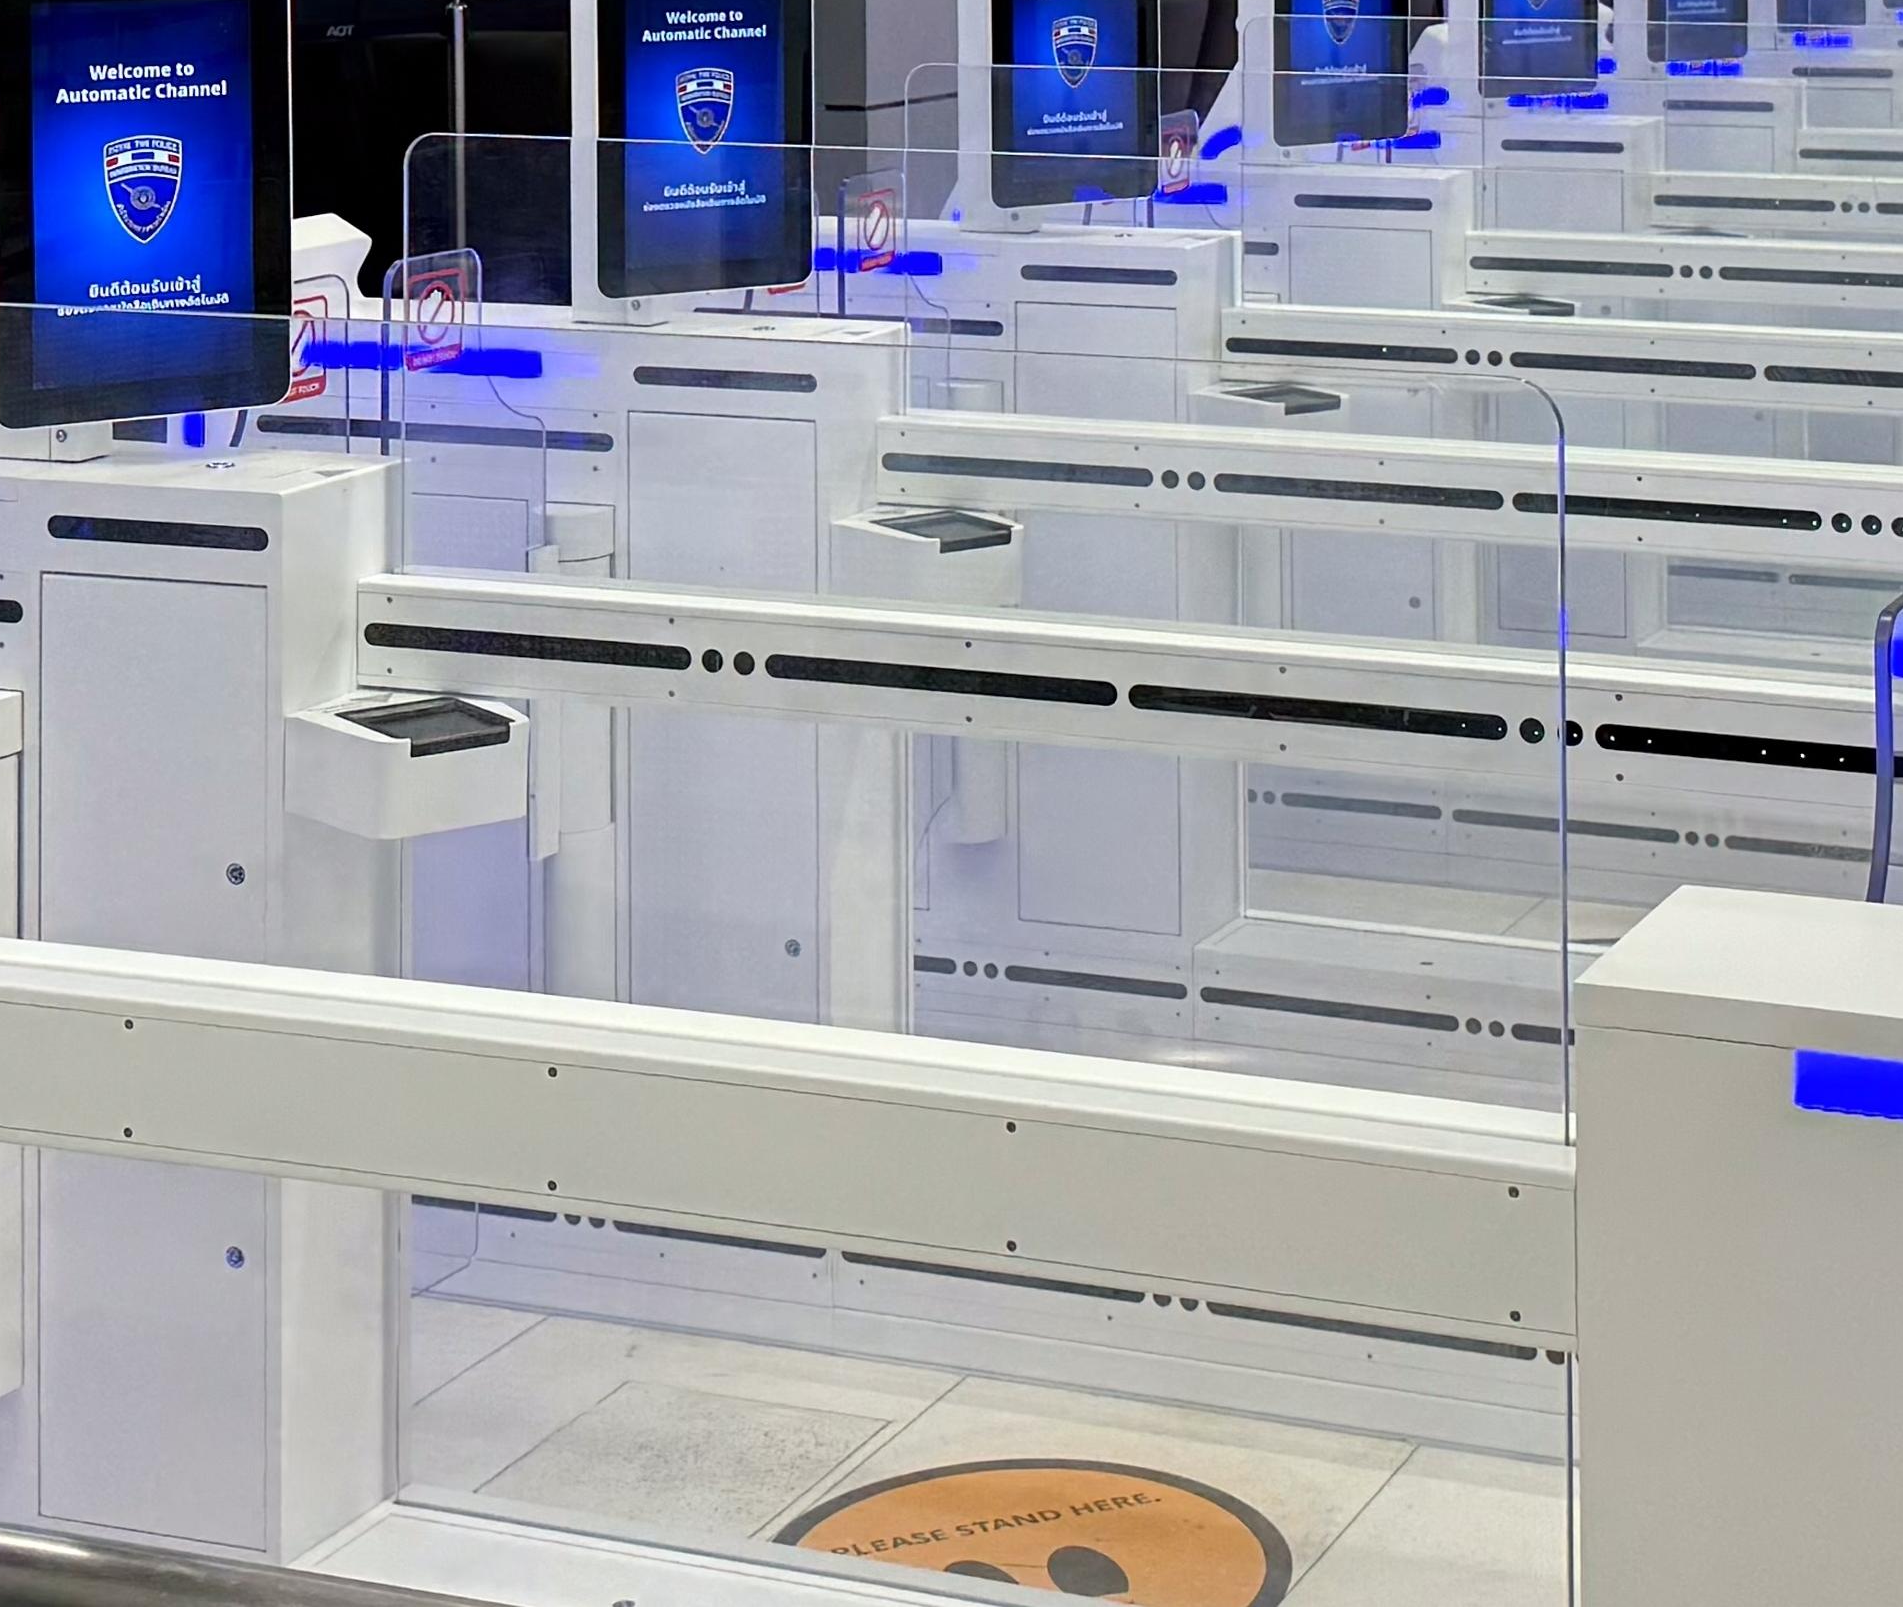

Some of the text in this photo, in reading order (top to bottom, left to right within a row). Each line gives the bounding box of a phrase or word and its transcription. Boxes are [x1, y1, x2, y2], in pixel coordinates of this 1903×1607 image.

[666, 10, 744, 25] Welcome to
[641, 24, 767, 43] Automatic Channel
[89, 62, 194, 81] Welcome to
[55, 80, 228, 104] Automatic Channel
[830, 1492, 1164, 1558] PLEASE STAND HERE.
